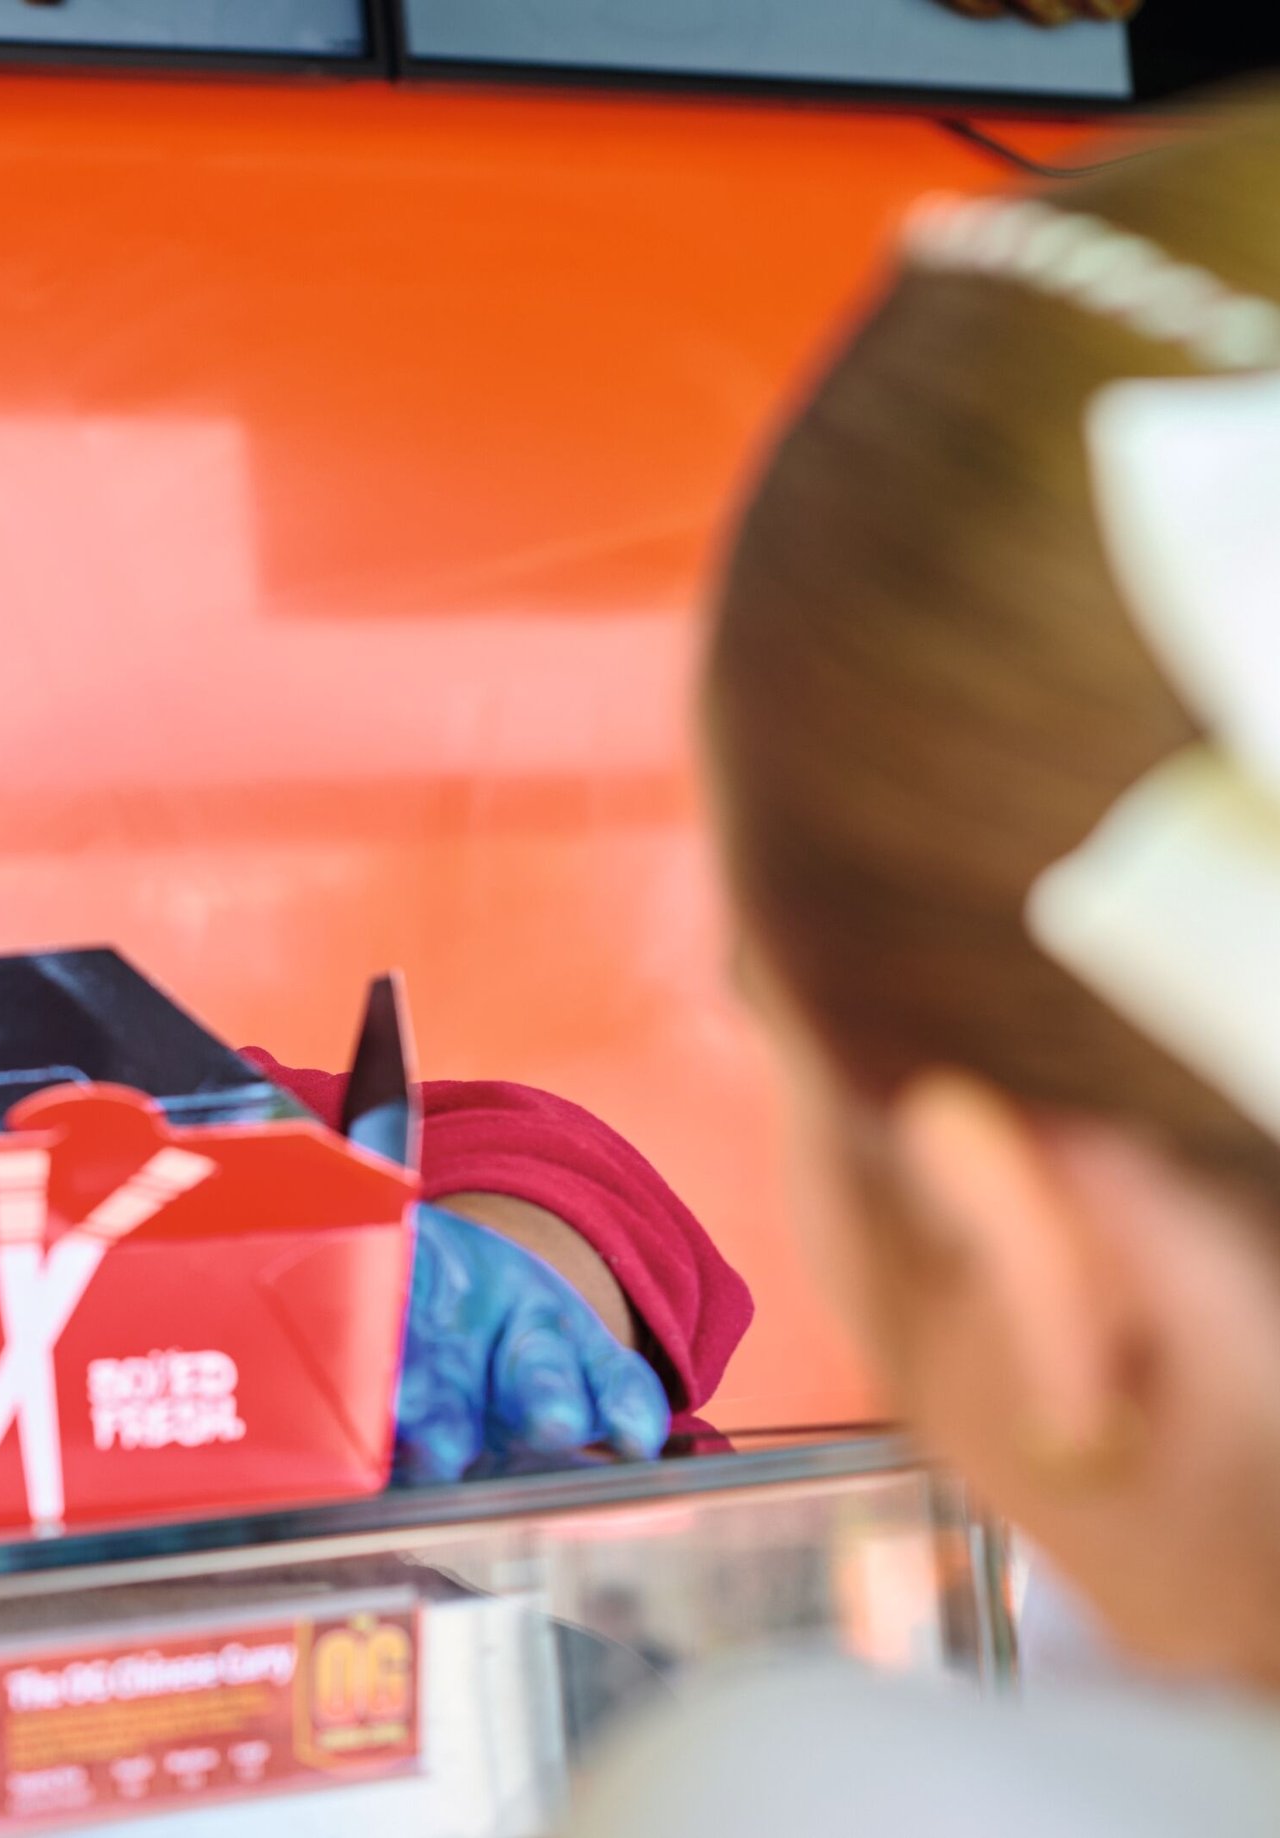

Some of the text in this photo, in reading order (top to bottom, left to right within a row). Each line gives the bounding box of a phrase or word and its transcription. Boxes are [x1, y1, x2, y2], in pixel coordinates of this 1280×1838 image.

[6, 1667, 62, 1711] The
[111, 1650, 219, 1700] Chinese
[219, 1643, 295, 1687] Curry
[315, 1627, 410, 1718] OG
